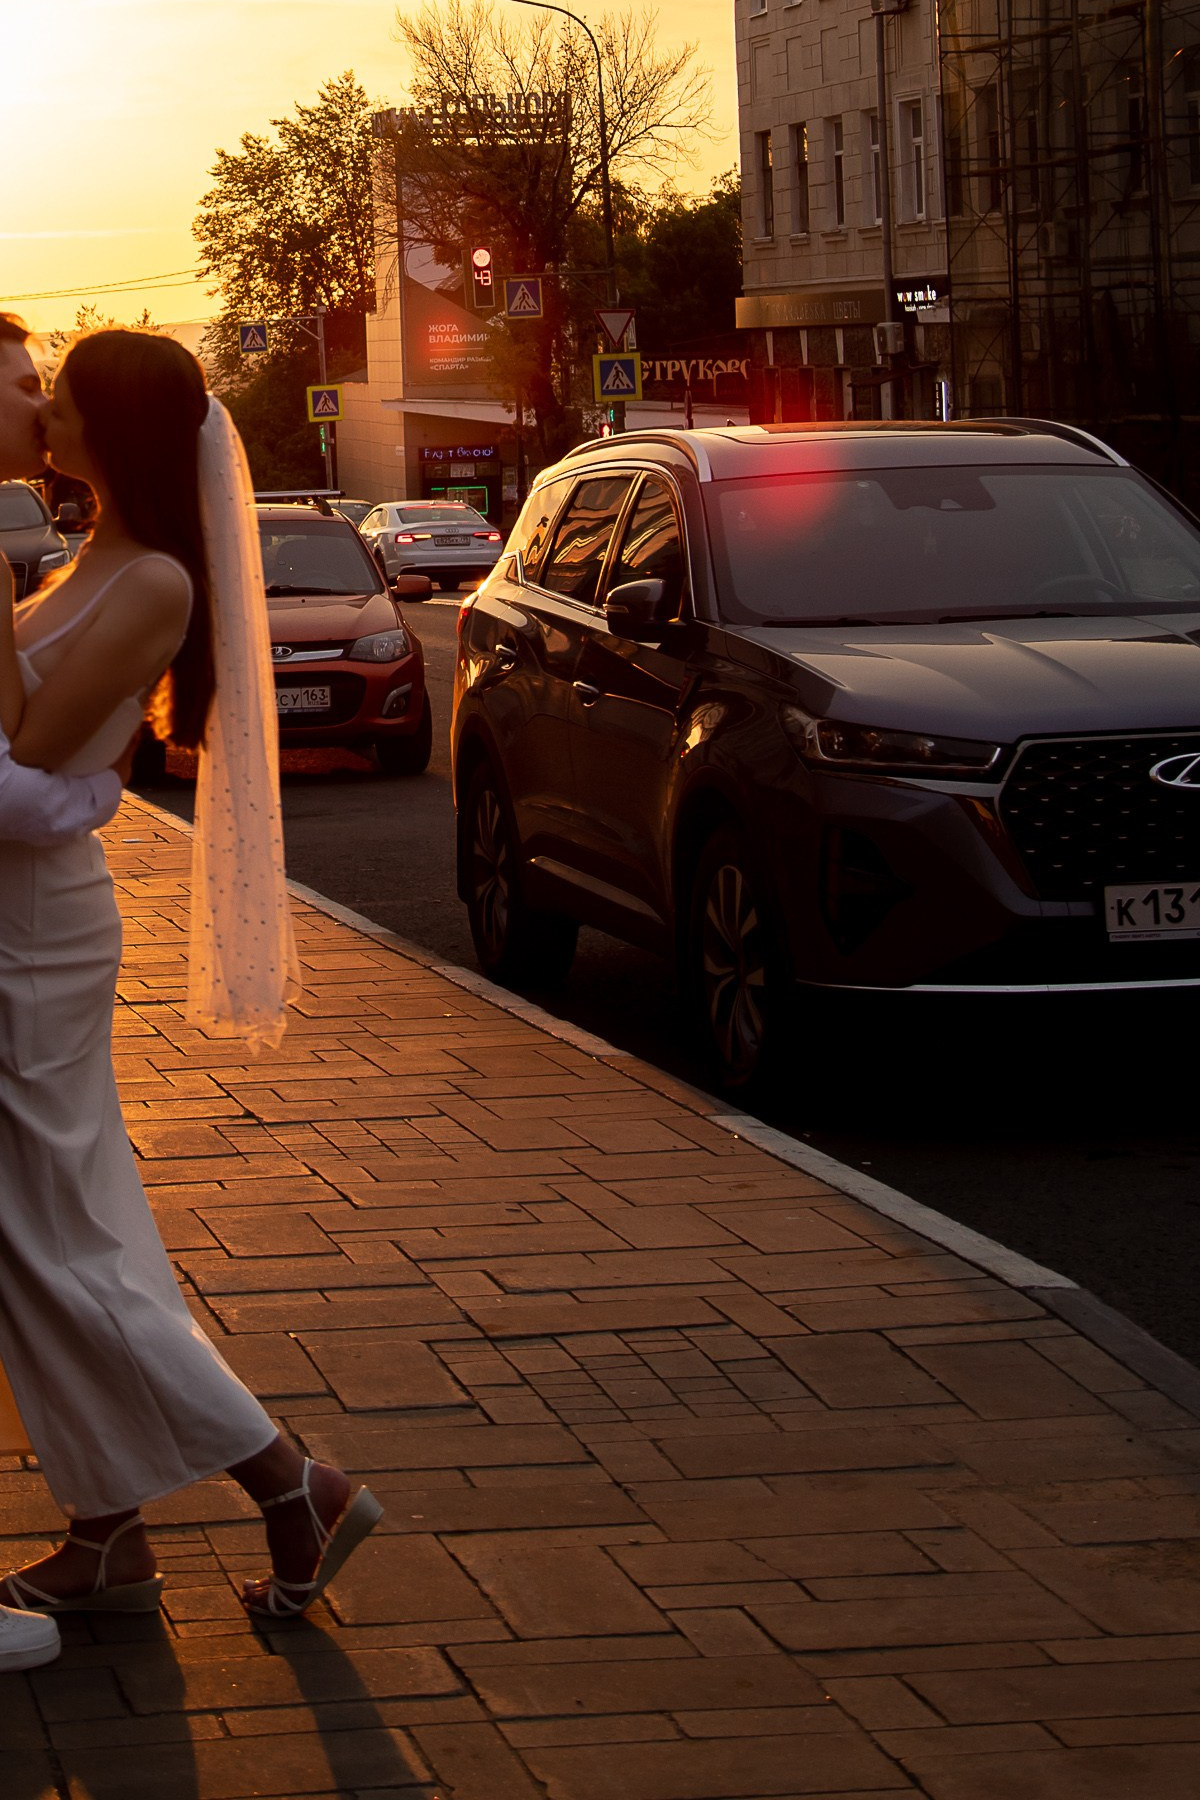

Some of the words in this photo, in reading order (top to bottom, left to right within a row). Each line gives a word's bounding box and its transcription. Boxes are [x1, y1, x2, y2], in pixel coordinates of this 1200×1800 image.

[474, 270, 492, 286] 43
[428, 324, 459, 333] ЖОГА
[303, 688, 326, 701] 163
